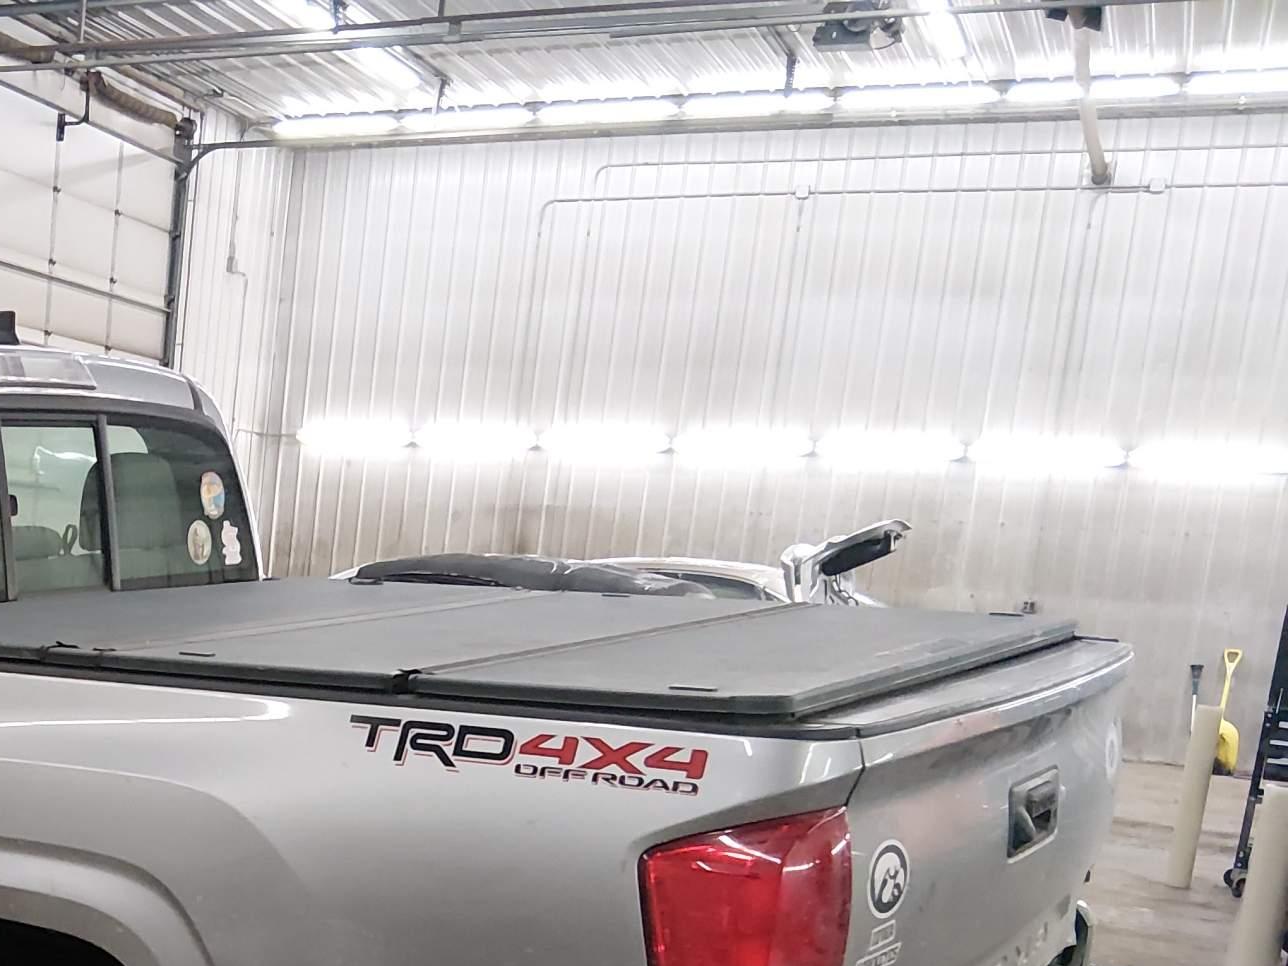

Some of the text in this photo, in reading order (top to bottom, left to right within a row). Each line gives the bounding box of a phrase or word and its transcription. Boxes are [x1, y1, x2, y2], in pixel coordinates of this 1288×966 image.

[350, 714, 708, 781] TRD 4X4
[514, 763, 699, 796] OFF ROAD
